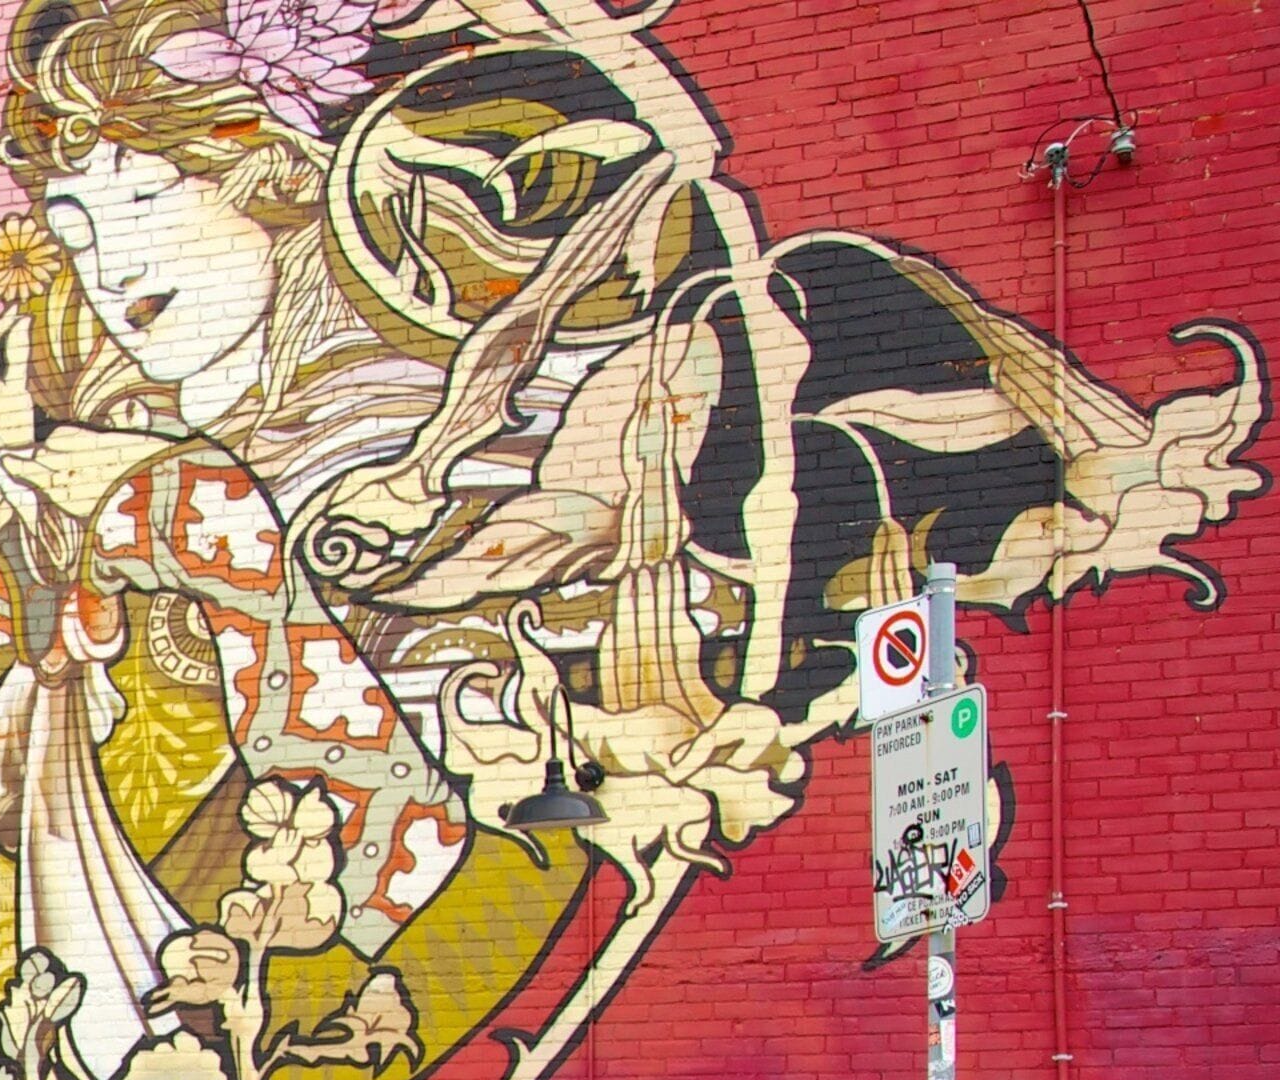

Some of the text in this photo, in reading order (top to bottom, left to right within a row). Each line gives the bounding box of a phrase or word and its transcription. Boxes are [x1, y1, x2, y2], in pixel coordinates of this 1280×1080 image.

[877, 724, 893, 739] PAY
[877, 732, 921, 757] ENFORCED
[898, 778, 924, 797] MON
[934, 768, 958, 786] SAT
[910, 796, 925, 811] AM
[932, 788, 953, 804] 9:00
[955, 782, 970, 798] PM
[917, 808, 940, 824] SUN
[952, 818, 966, 833] PM
